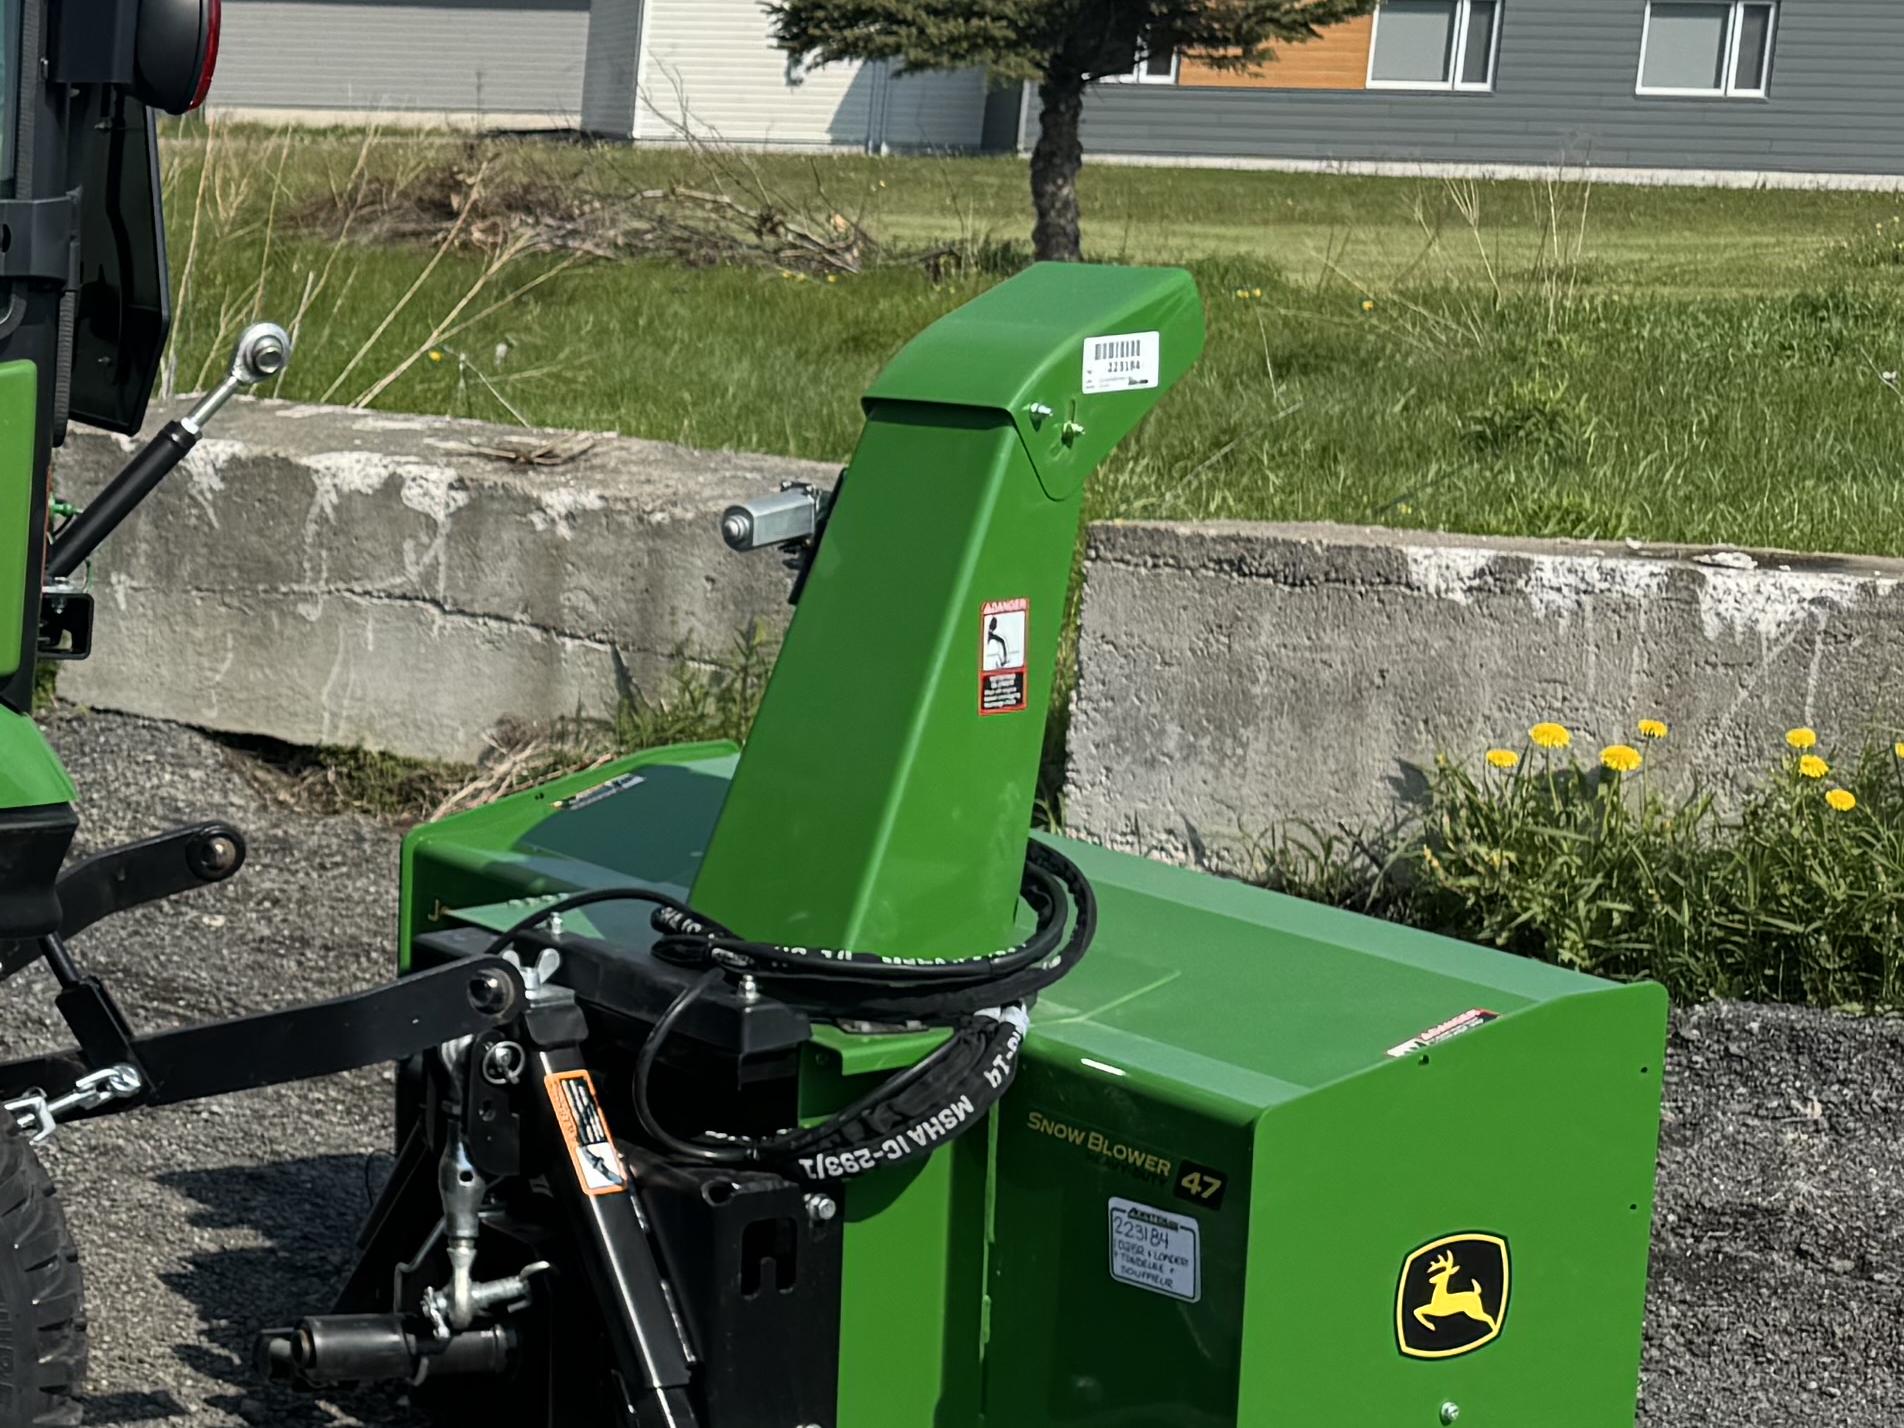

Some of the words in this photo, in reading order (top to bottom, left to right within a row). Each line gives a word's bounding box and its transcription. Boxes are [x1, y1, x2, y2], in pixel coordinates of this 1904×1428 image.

[907, 1094, 975, 1147] MSHA
[798, 1135, 911, 1180] IC-293/1
[1027, 1112, 1086, 1145] SNOW
[1088, 1131, 1172, 1177] BLOWER
[1180, 1172, 1222, 1199] 47
[1112, 1216, 1169, 1249] 223184
